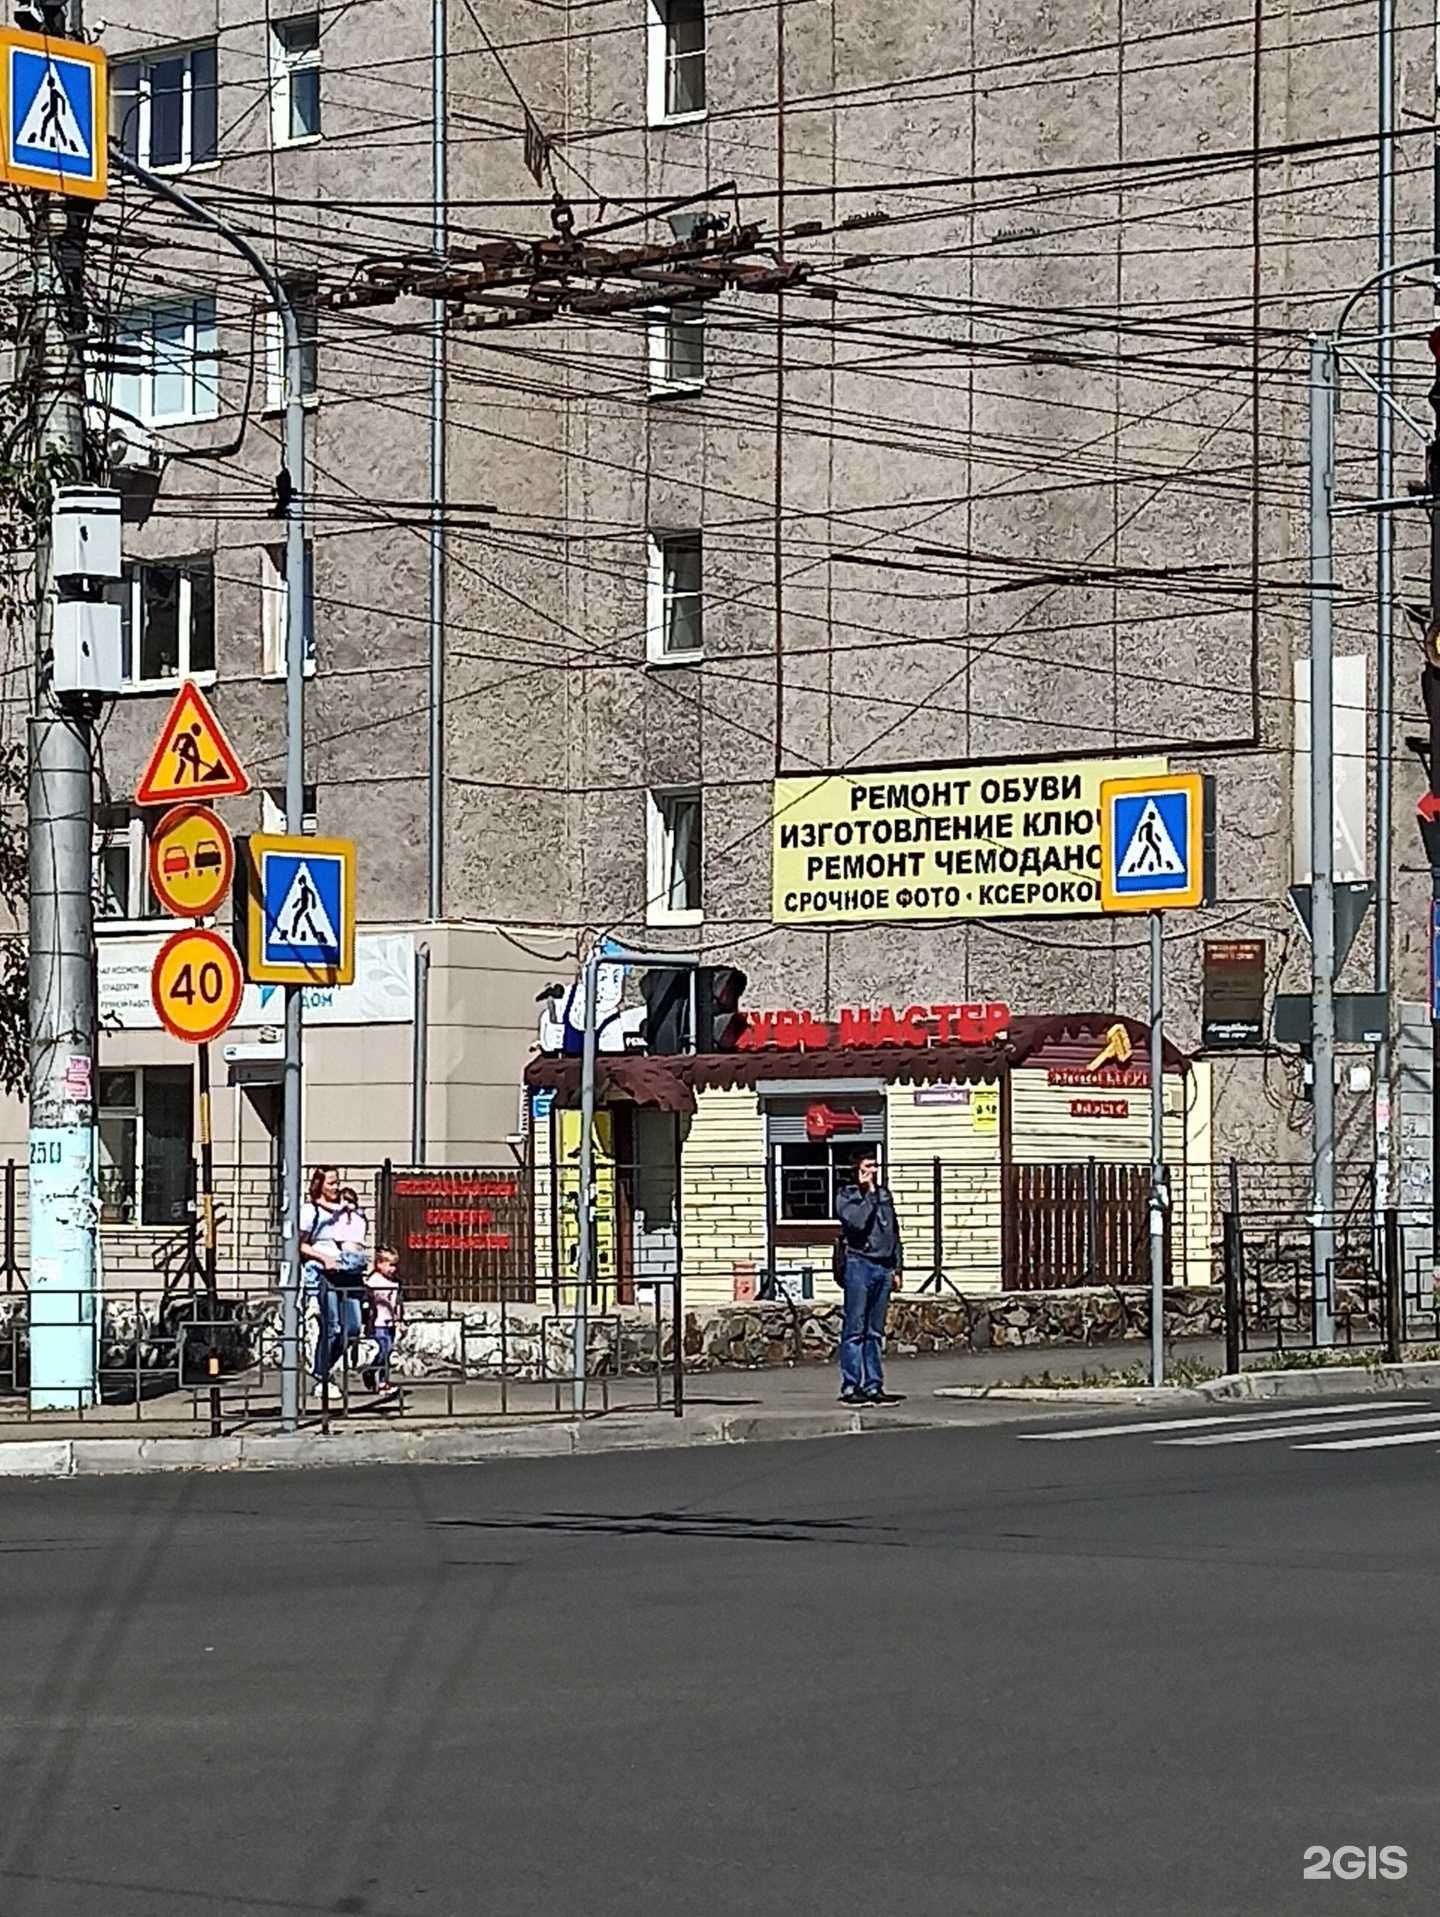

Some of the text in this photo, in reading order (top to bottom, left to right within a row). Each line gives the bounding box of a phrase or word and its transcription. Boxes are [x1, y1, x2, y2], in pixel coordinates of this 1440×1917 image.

[851, 775, 1082, 811] РЕМОНТ ОБУВИ
[780, 808, 1101, 849] ИЗГОТОВЛЕНИЕ КЛЮ
[807, 852, 925, 881] РЕМОНТ
[784, 889, 889, 913] СРОЧНОЕ
[896, 885, 960, 909] ФОТО
[169, 961, 223, 1005] 40
[840, 1002, 1010, 1048] МАСТЕР
